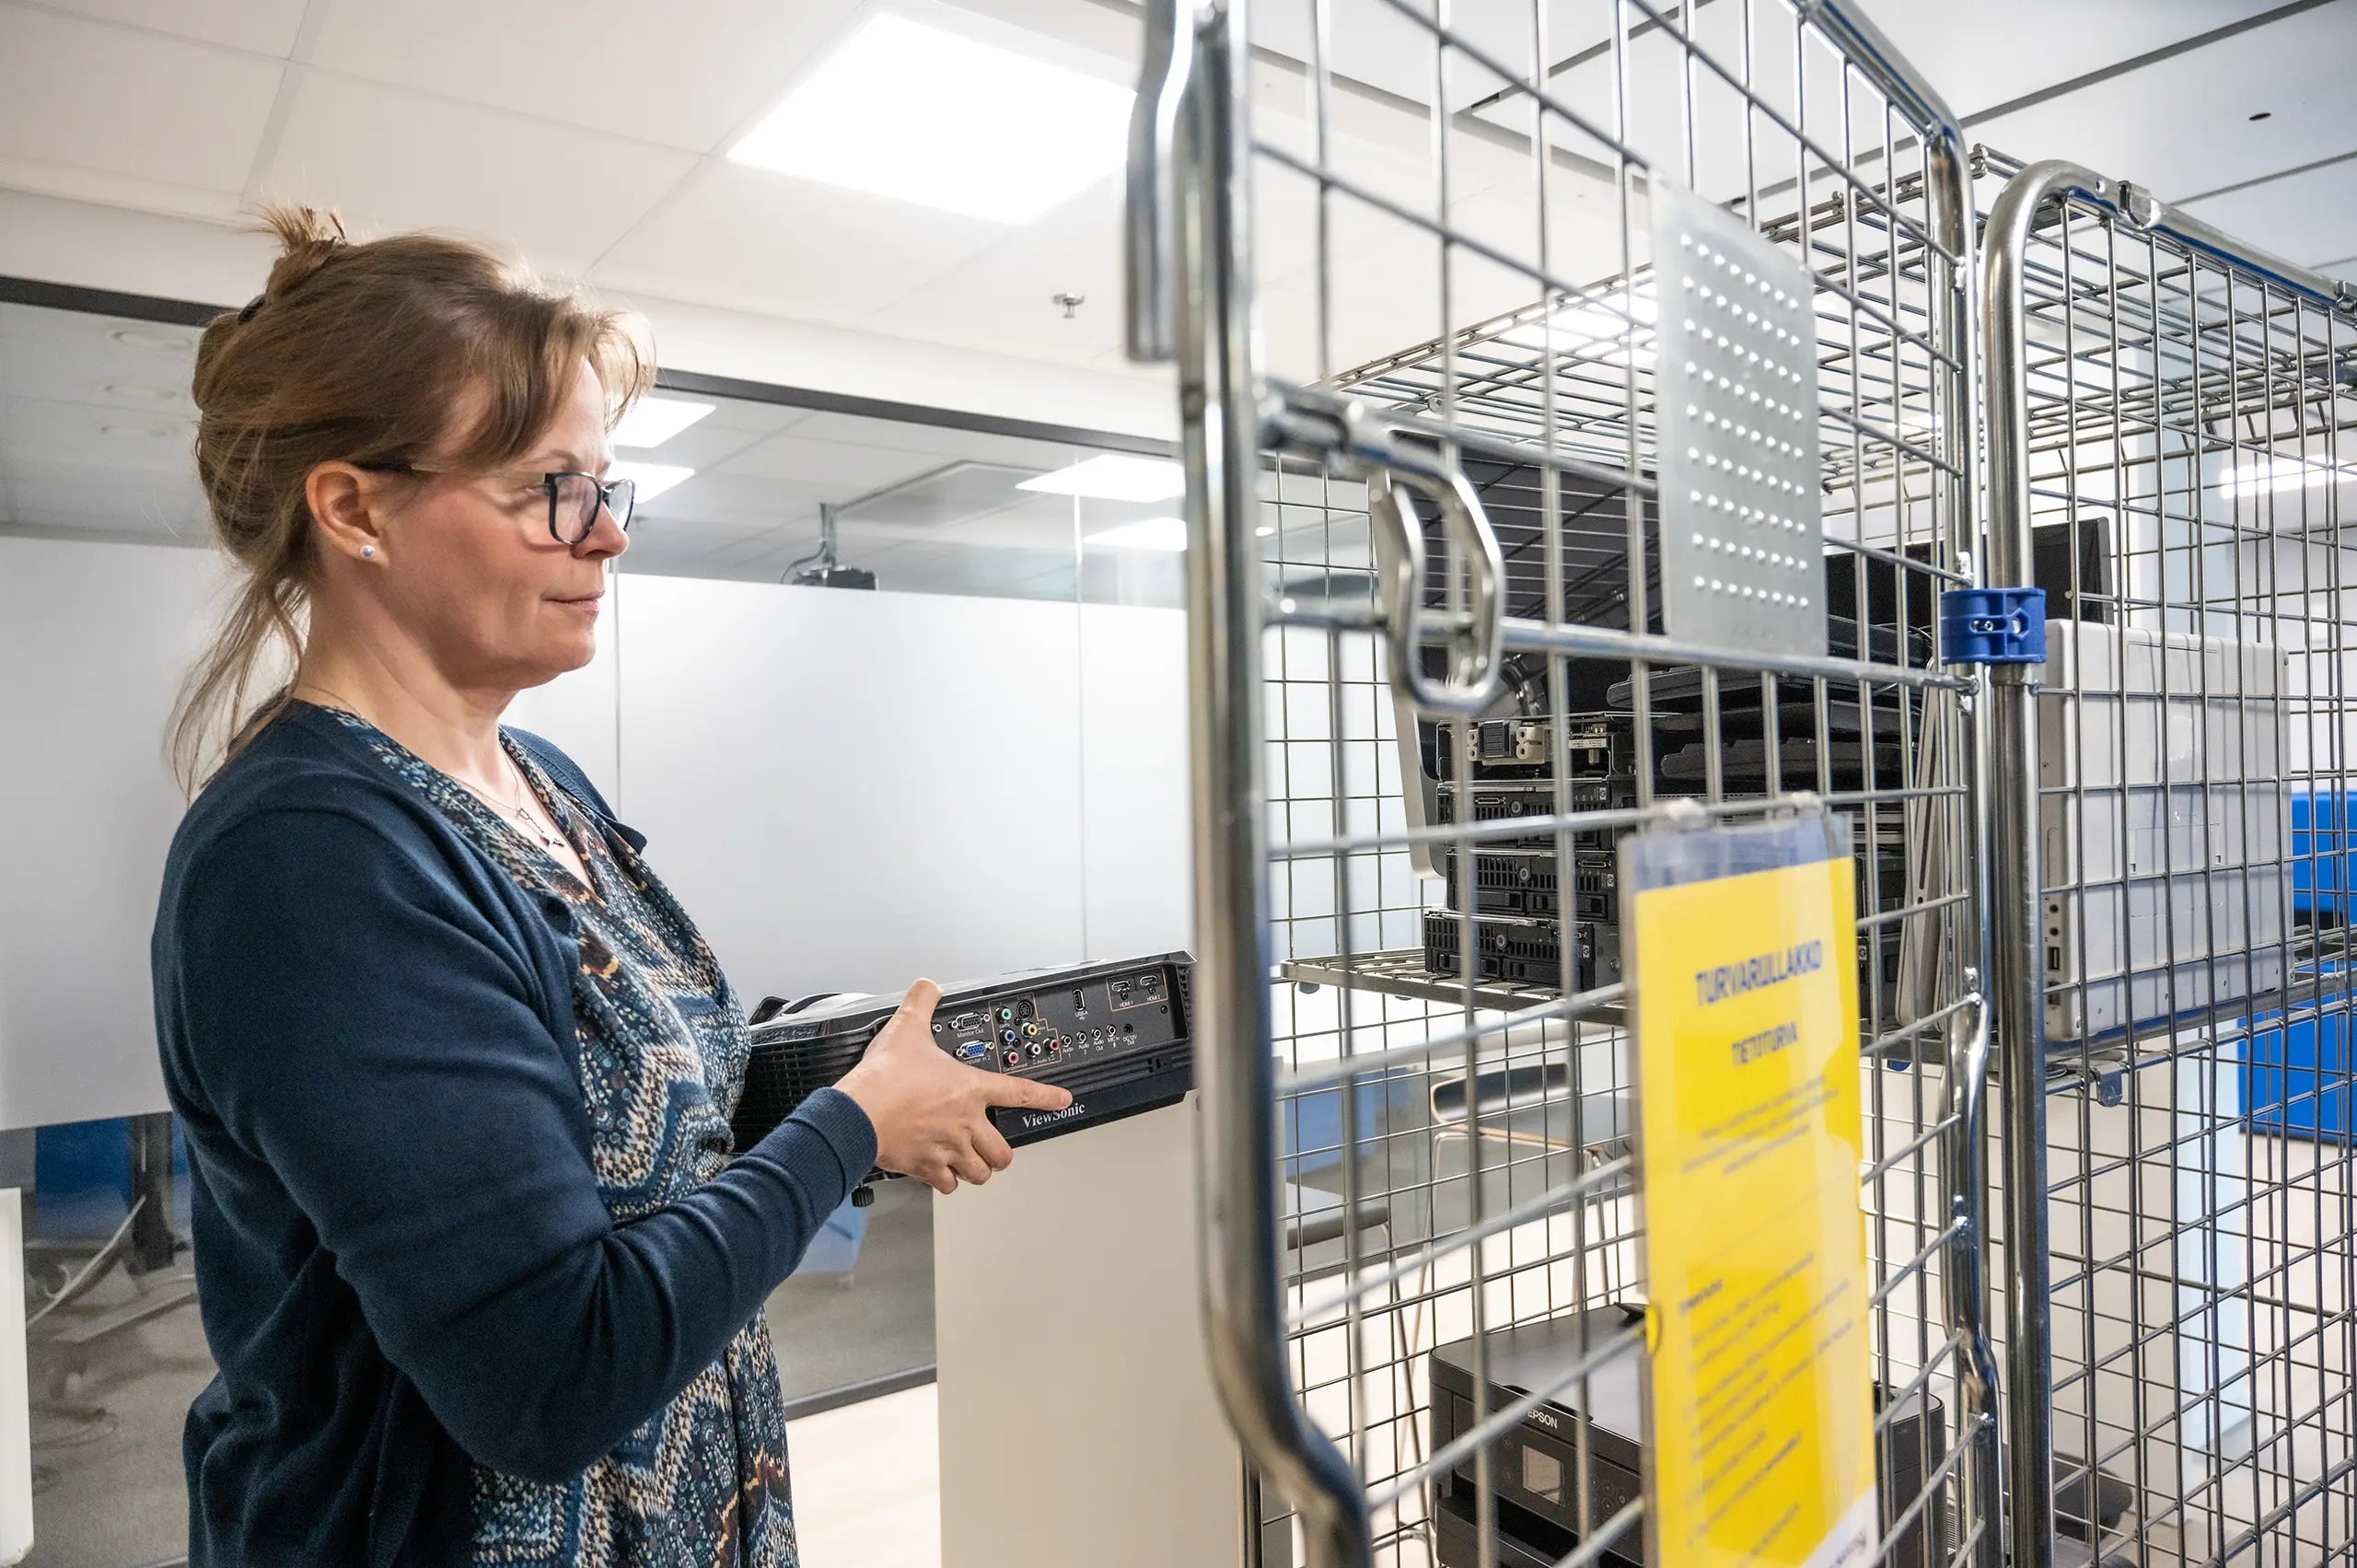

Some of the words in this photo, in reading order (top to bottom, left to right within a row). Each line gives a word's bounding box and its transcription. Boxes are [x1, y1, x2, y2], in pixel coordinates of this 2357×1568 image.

[958, 1030, 975, 1039] Monitor
[1022, 1102, 1086, 1129] ViewSonic
[1527, 1409, 1558, 1429] EPSON
